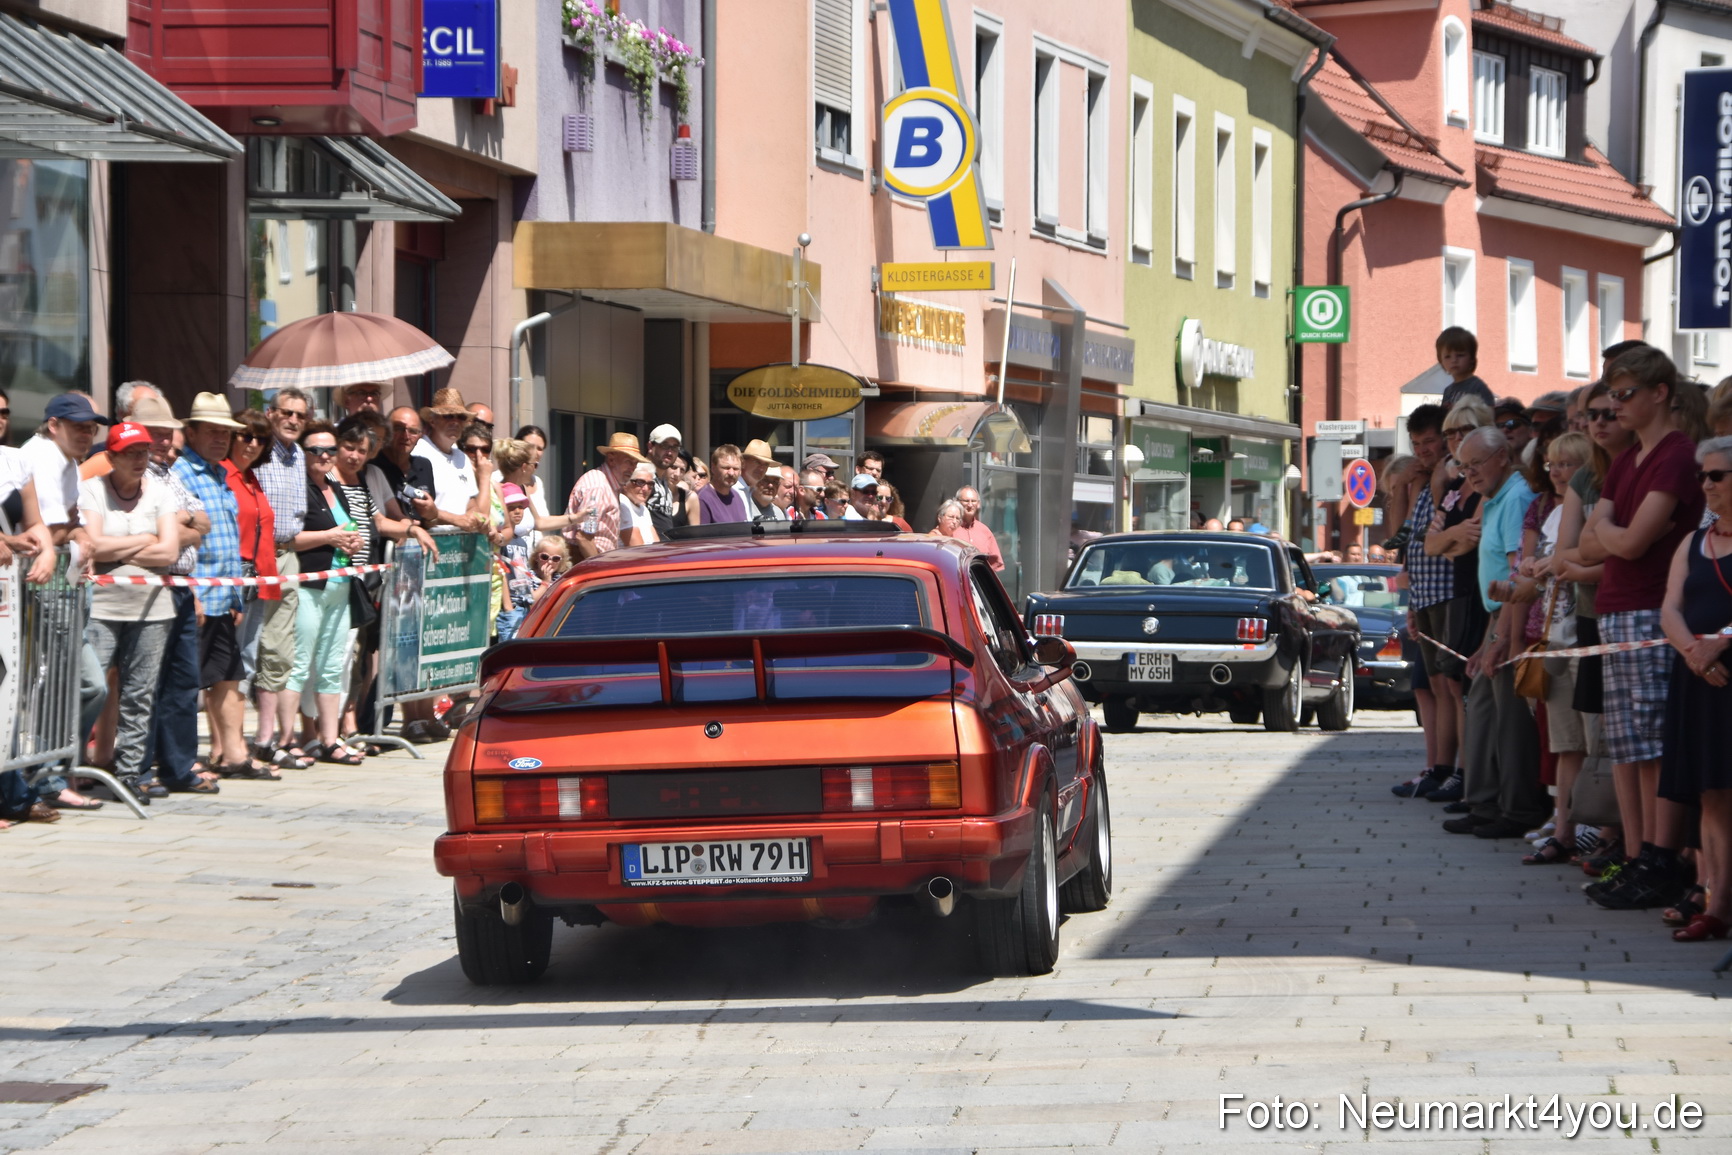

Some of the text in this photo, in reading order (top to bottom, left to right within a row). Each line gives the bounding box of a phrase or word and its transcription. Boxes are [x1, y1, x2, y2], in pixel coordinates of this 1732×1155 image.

[893, 116, 943, 168] B
[888, 270, 985, 282] KLOSTERGASSE 4
[734, 387, 860, 398] DIE GOLDSCHMIEDE
[1318, 423, 1357, 432] Klostergasse
[1342, 448, 1360, 456] gasse
[423, 624, 446, 647] sicheren
[1139, 652, 1162, 666] ERH
[1130, 667, 1170, 680] MY 65H
[514, 758, 537, 768] Ford
[642, 841, 805, 874] LIP RW 79H
[629, 864, 636, 873] D
